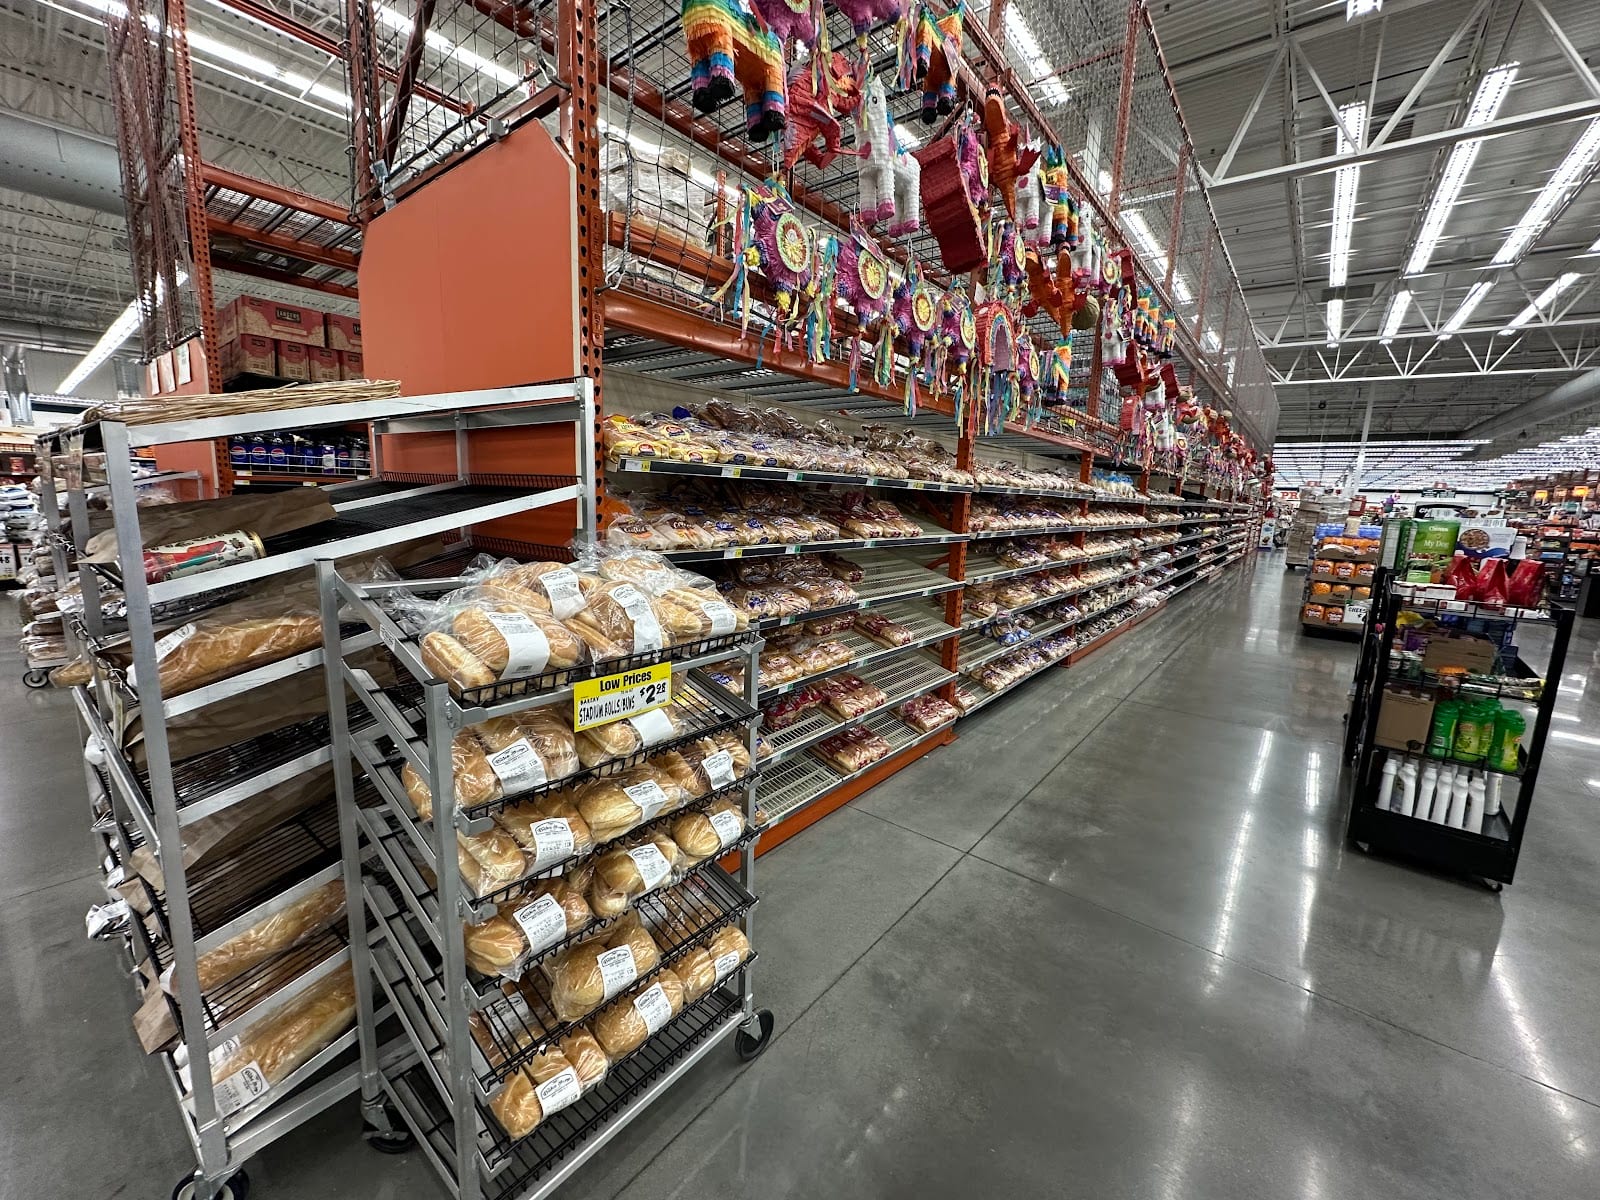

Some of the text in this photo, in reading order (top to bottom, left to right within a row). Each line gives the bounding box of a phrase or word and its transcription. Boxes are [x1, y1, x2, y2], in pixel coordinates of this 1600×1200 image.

[1280, 491, 1299, 499] PR
[600, 679, 620, 692] Low
[623, 671, 652, 687] Prices
[579, 704, 604, 723] STADIUM
